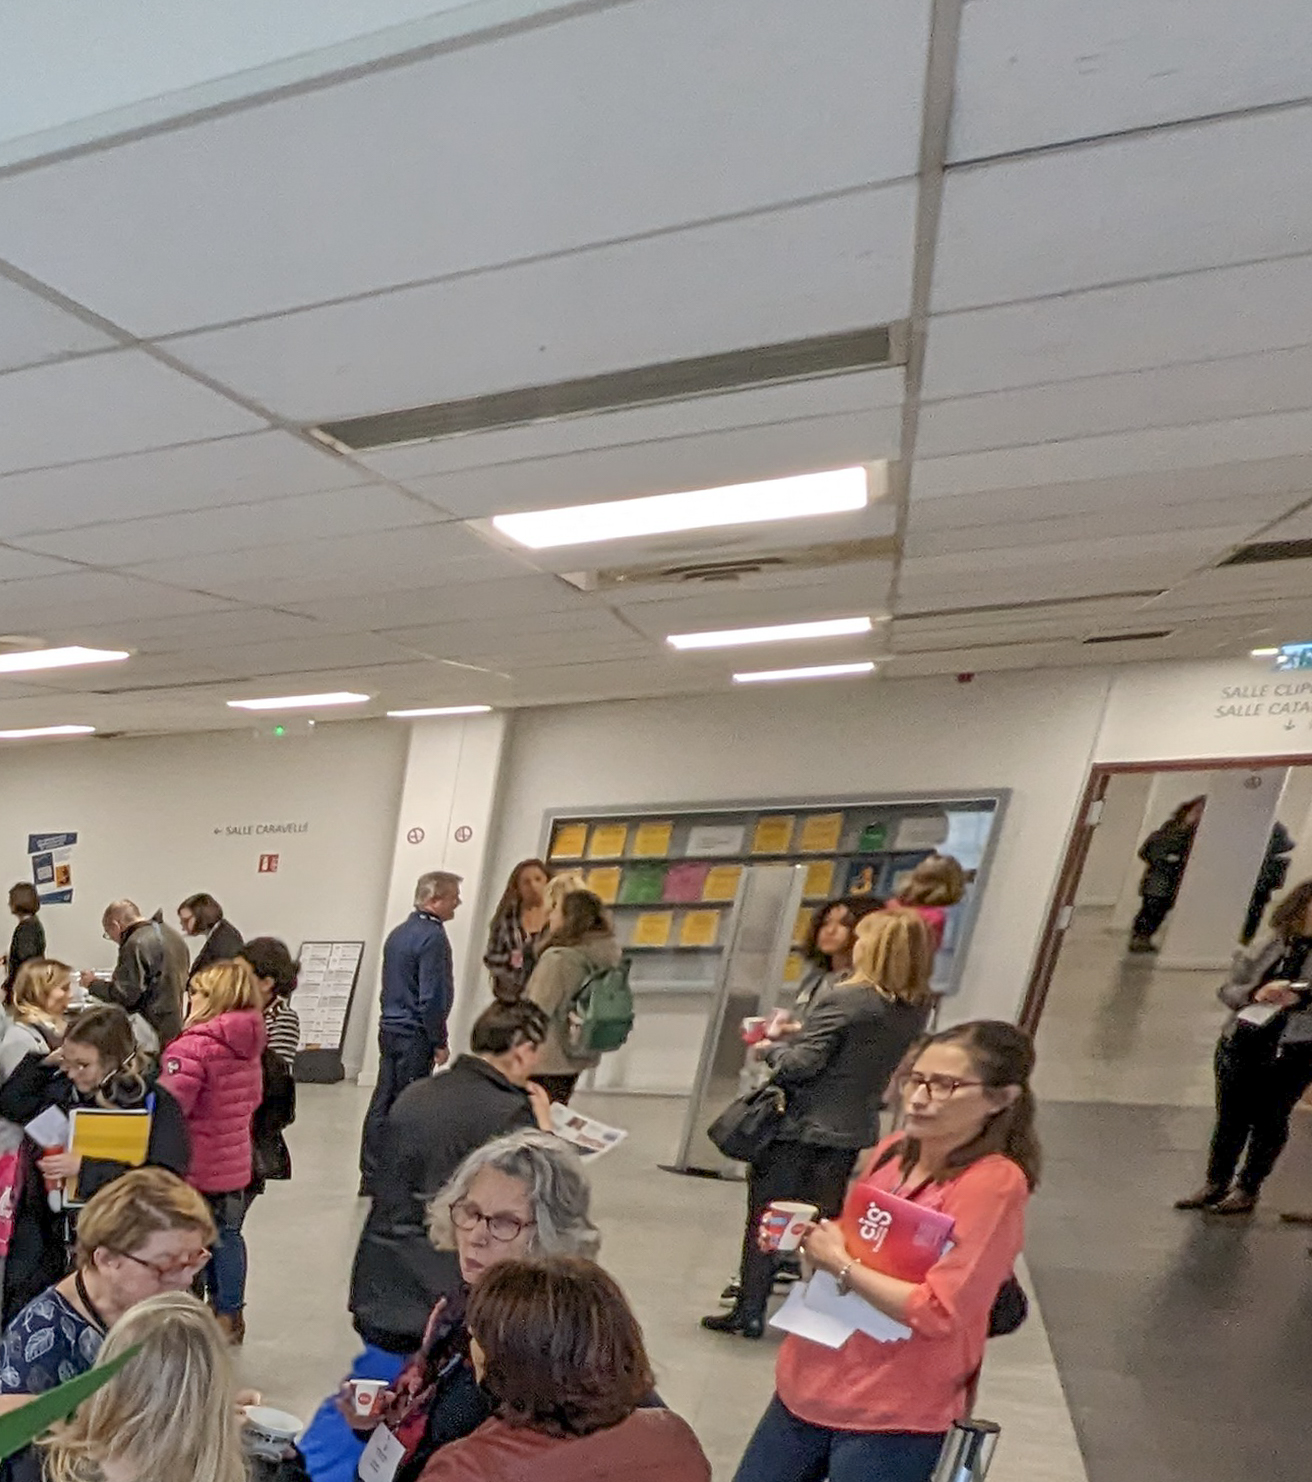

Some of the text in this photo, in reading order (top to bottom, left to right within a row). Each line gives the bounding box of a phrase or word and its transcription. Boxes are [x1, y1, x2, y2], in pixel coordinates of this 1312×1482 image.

[1221, 682, 1312, 699] SALLE CLIP
[1214, 701, 1312, 718] SALLE CATA
[226, 822, 309, 836] SALLE CARAVELLE
